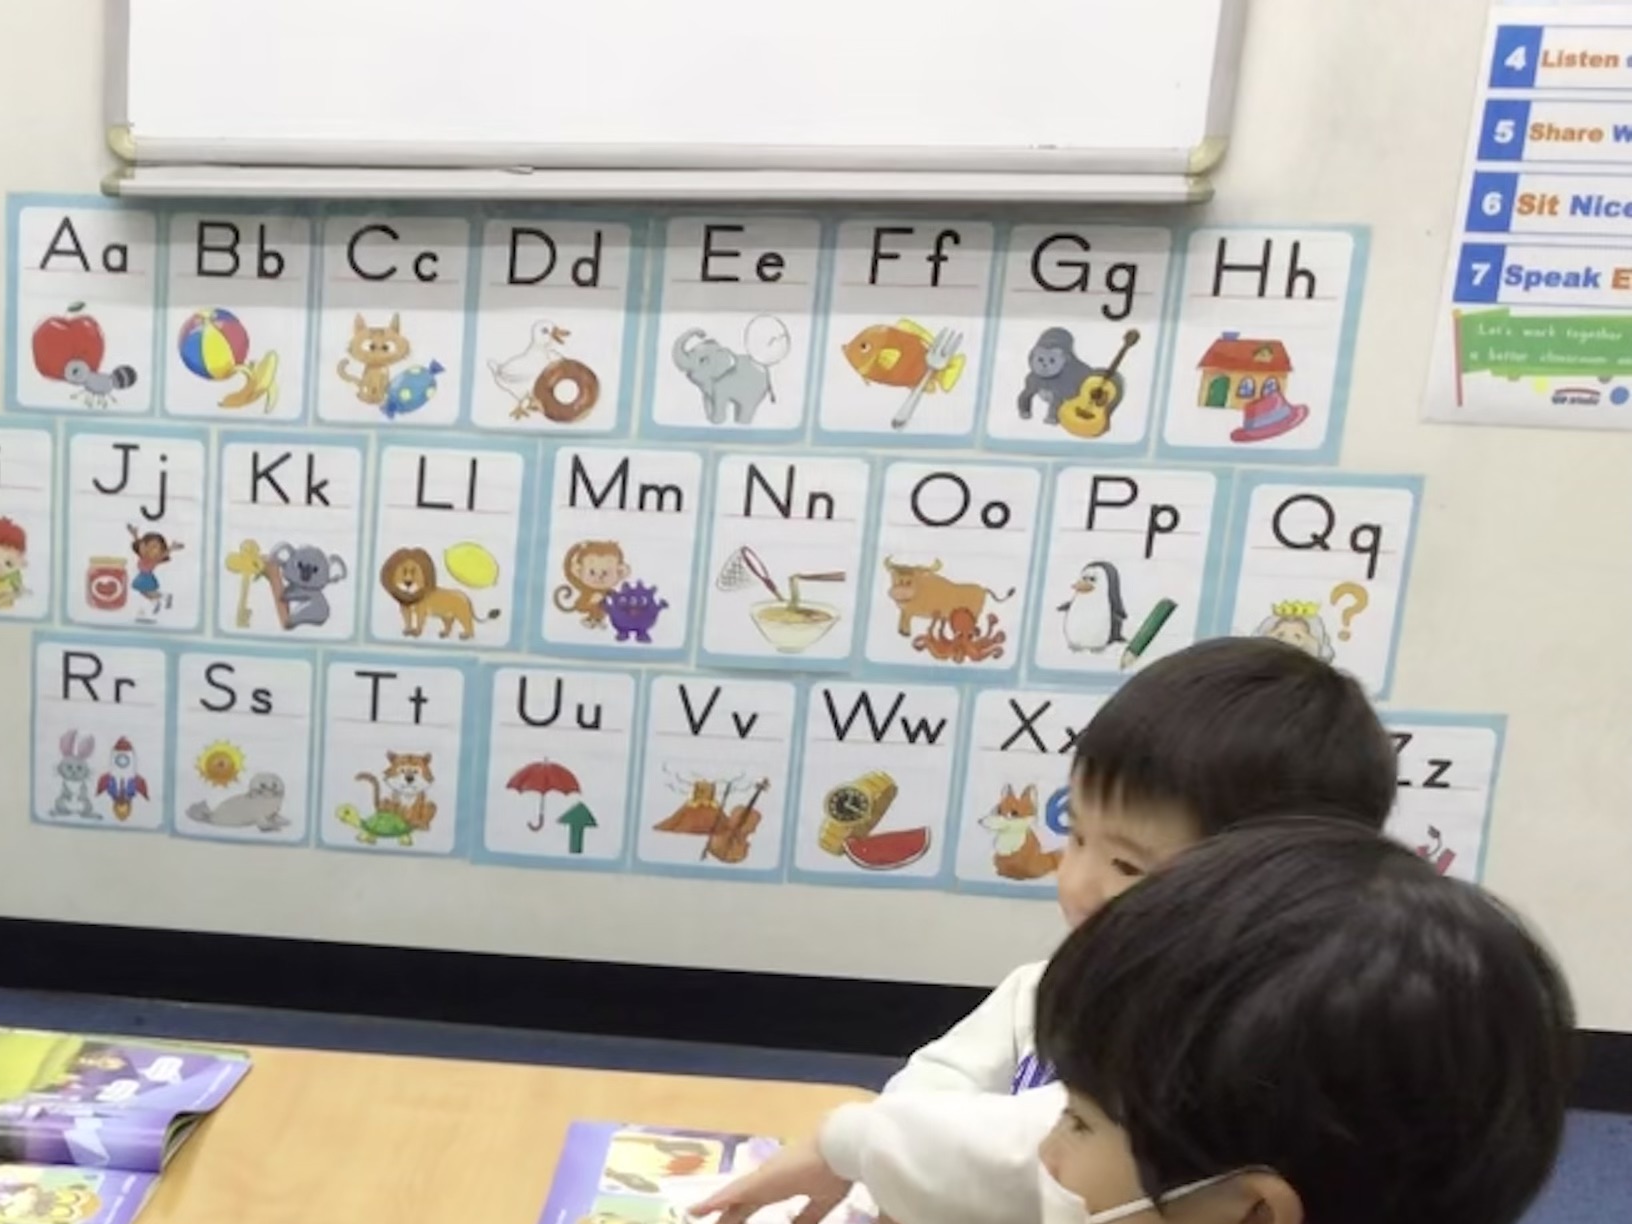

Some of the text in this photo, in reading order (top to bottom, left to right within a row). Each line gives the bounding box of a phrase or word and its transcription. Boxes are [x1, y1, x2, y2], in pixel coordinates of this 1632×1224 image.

[1504, 45, 1526, 71] 4
[1541, 49, 1620, 68] Listen
[1493, 119, 1515, 144] 5
[1529, 122, 1604, 142] Share
[1481, 191, 1502, 216] 6
[1517, 193, 1559, 216] Sit
[40, 217, 129, 272] Aa
[197, 221, 285, 280] Bb
[347, 224, 439, 283] Cc
[507, 227, 603, 288] Dd
[701, 225, 785, 283] Ee
[869, 227, 961, 287] Ff
[1212, 238, 1316, 300] Hh
[1030, 233, 1138, 322] Gg
[1471, 262, 1491, 286] 7
[1504, 264, 1601, 292] Speak
[93, 444, 168, 521] Jj
[251, 452, 330, 507] Kk
[416, 456, 478, 511] Ll
[569, 455, 683, 512] Mm
[743, 464, 834, 520] Nn
[911, 472, 1011, 529] Oo
[1086, 475, 1180, 559] Pp
[1272, 493, 1382, 580] Qq
[63, 651, 135, 703] Rr
[200, 663, 273, 715] Ss
[355, 671, 428, 725] Tt
[518, 676, 602, 731] Uu
[679, 684, 758, 739] Vv
[823, 689, 947, 745] Ww
